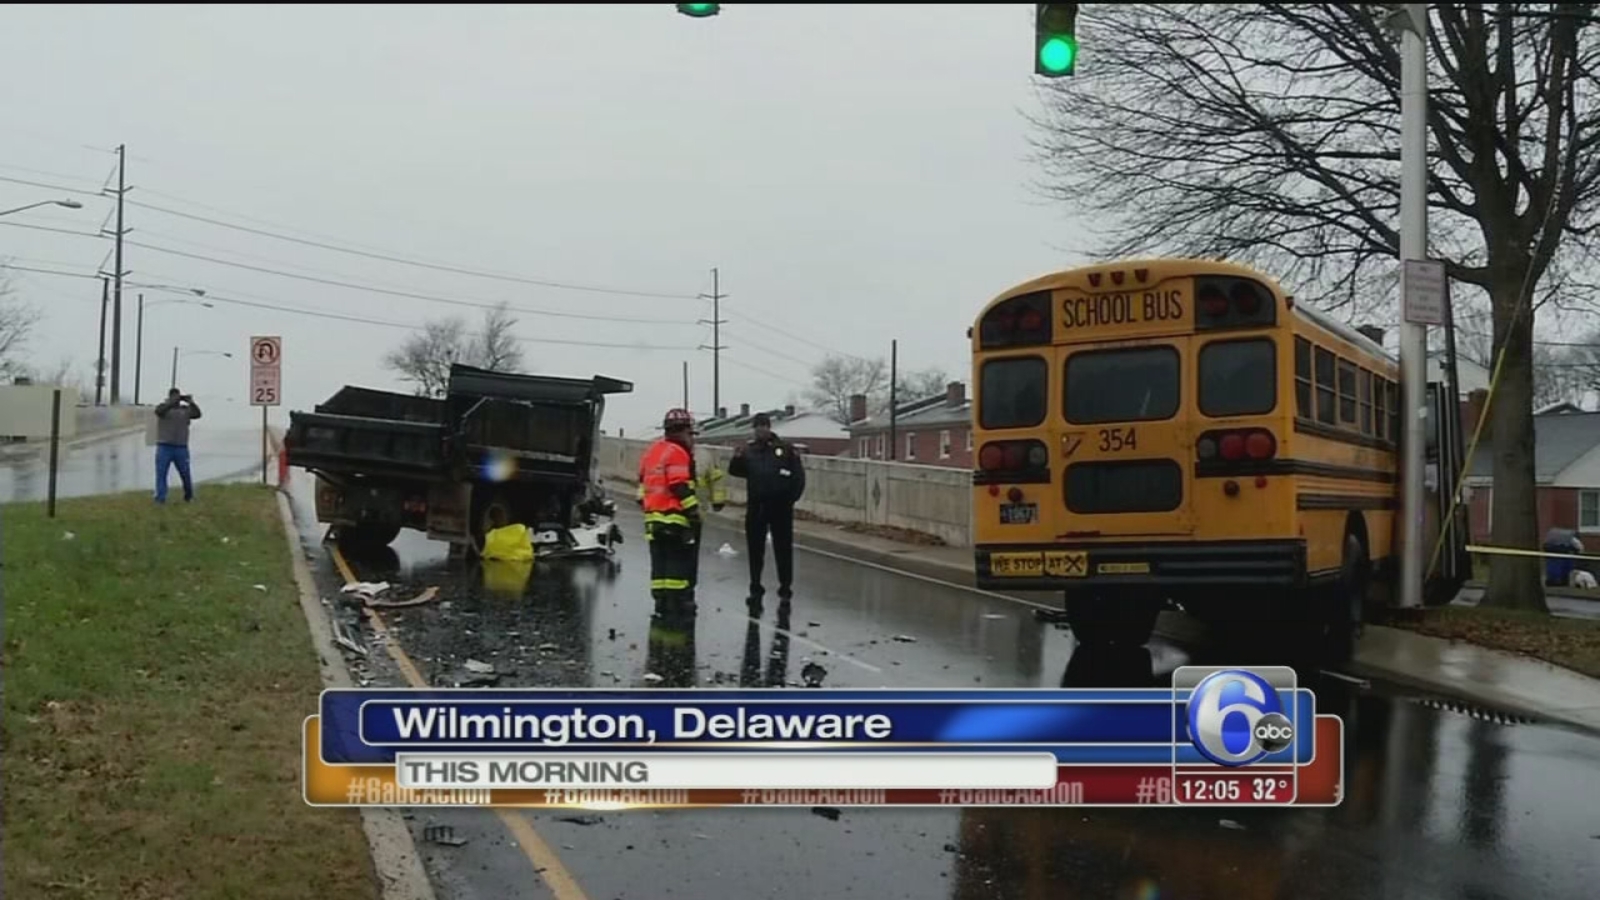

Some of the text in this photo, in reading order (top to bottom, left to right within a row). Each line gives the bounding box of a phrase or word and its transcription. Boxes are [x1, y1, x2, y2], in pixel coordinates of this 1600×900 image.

[1062, 290, 1184, 329] SCHOOL BUS
[255, 387, 276, 403] 25
[1098, 427, 1137, 452] 354
[1013, 556, 1042, 570] STOP
[1049, 556, 1063, 570] AT
